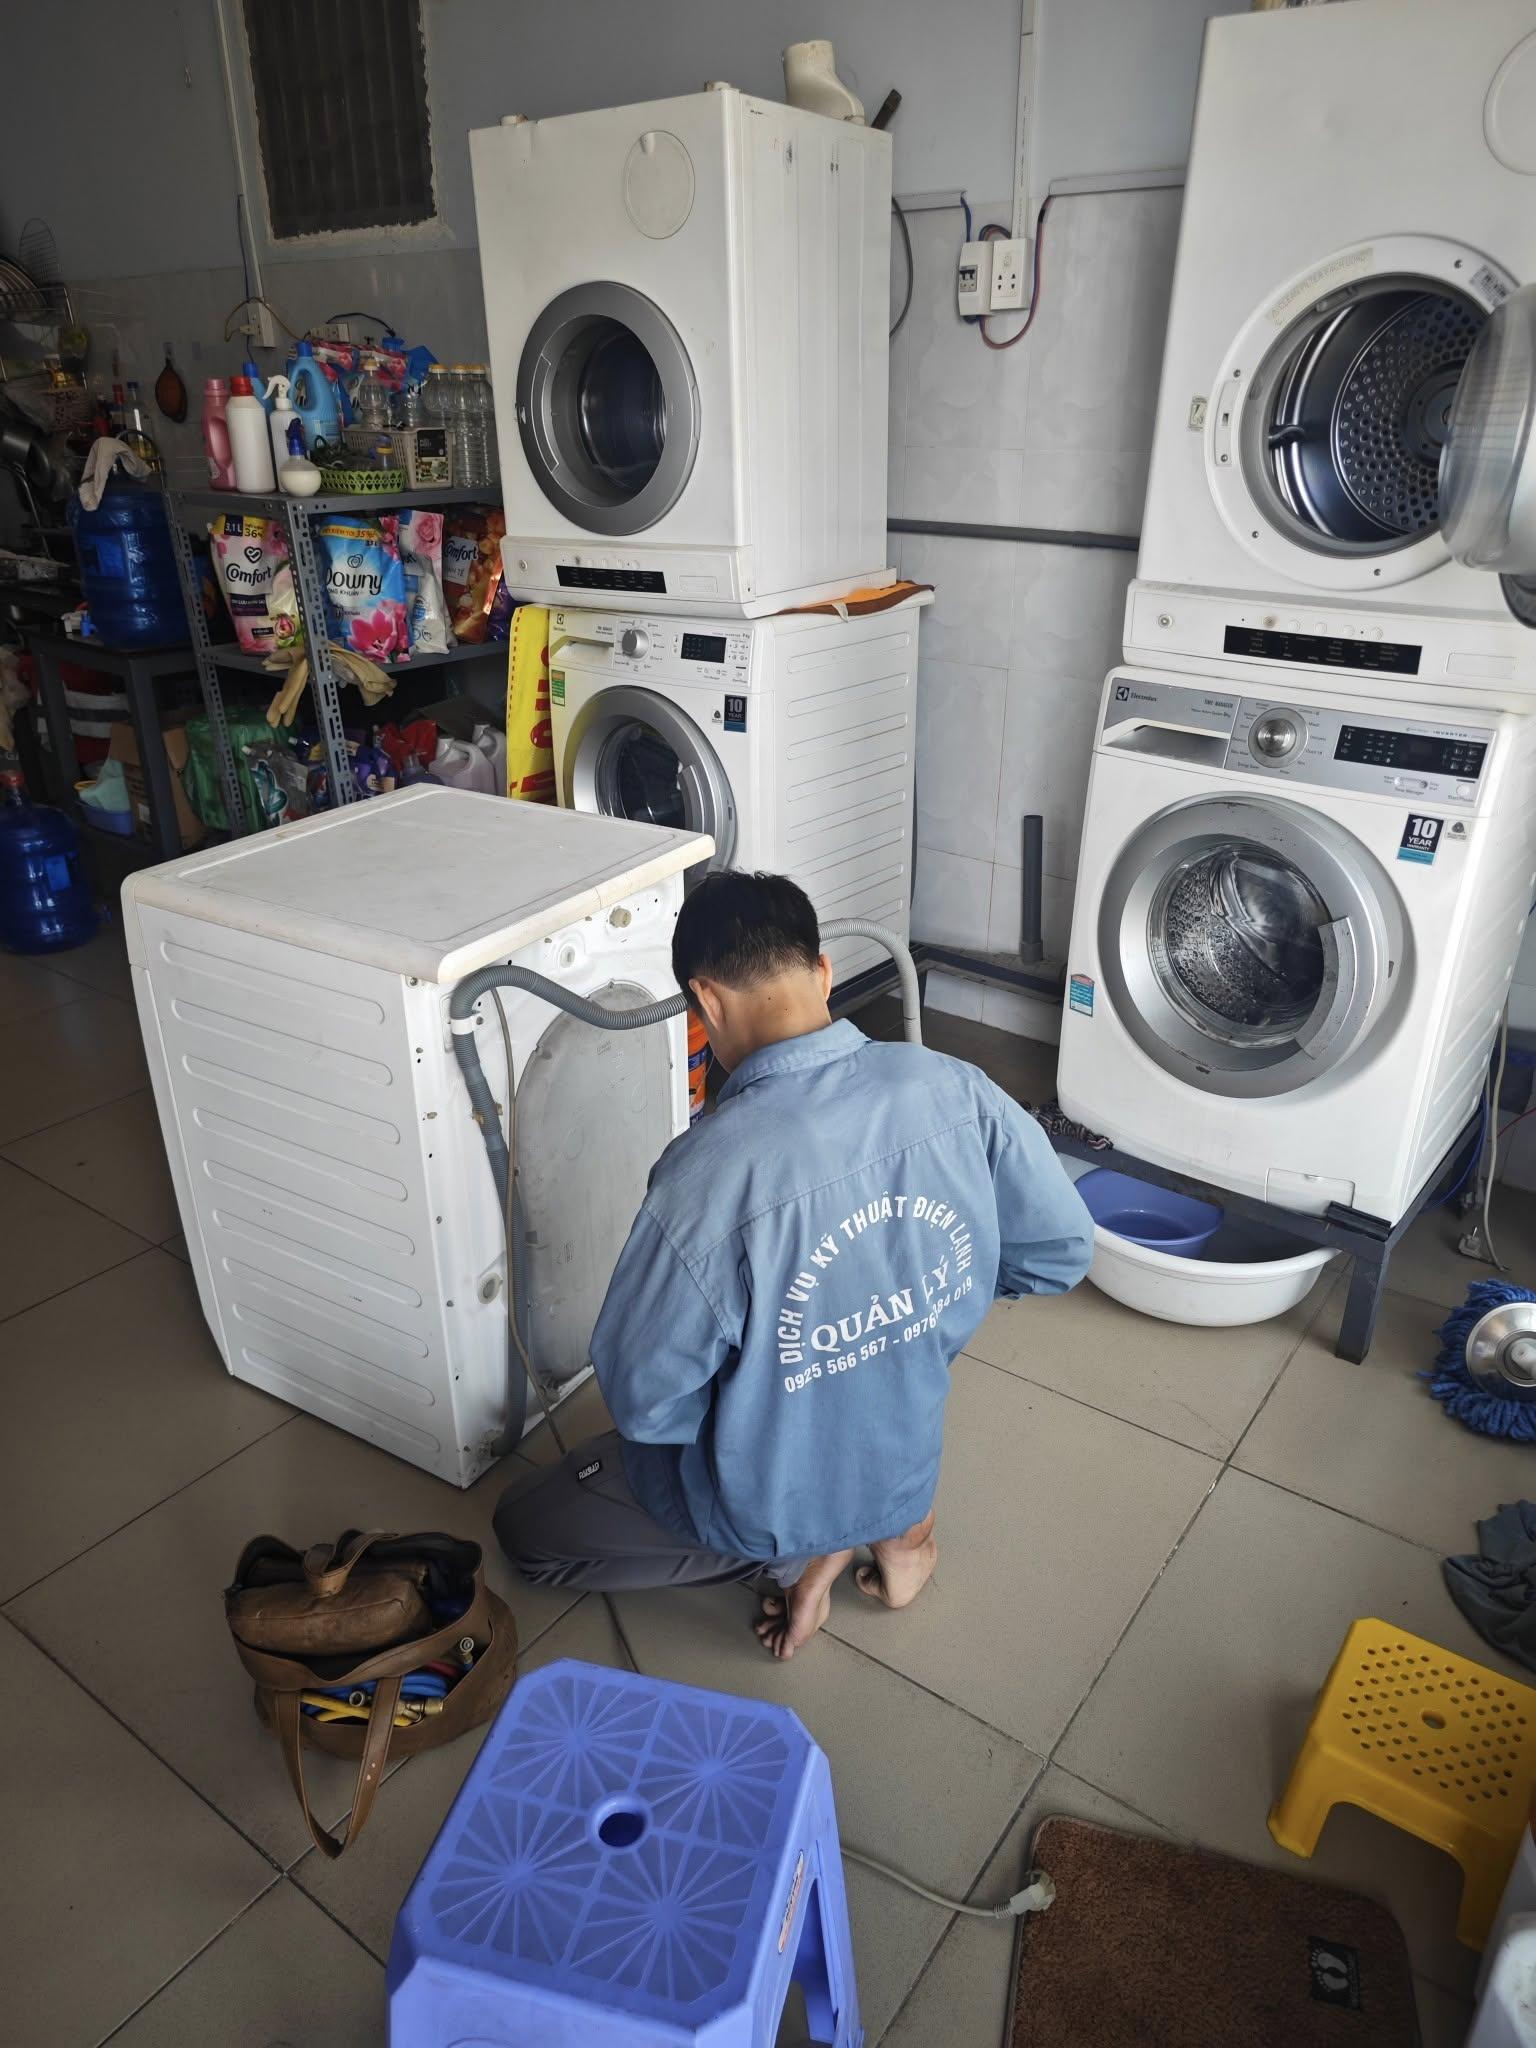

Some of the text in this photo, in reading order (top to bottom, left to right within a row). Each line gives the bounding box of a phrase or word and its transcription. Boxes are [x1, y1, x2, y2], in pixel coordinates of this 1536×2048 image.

[226, 563, 272, 586] Comfort
[728, 699, 743, 713] 10
[1408, 836, 1432, 846] YEAR
[1412, 818, 1438, 839] 10
[839, 1190, 908, 1241] THUẬT
[810, 1232, 840, 1269] KỸ
[786, 1271, 820, 1303] VỤ
[811, 1254, 949, 1353] QUẢN LÝ
[778, 1308, 806, 1365] DỊCH
[784, 1362, 822, 1393] 0925
[827, 1351, 857, 1375] 566
[860, 1336, 887, 1361] 567
[954, 1275, 973, 1302] 019
